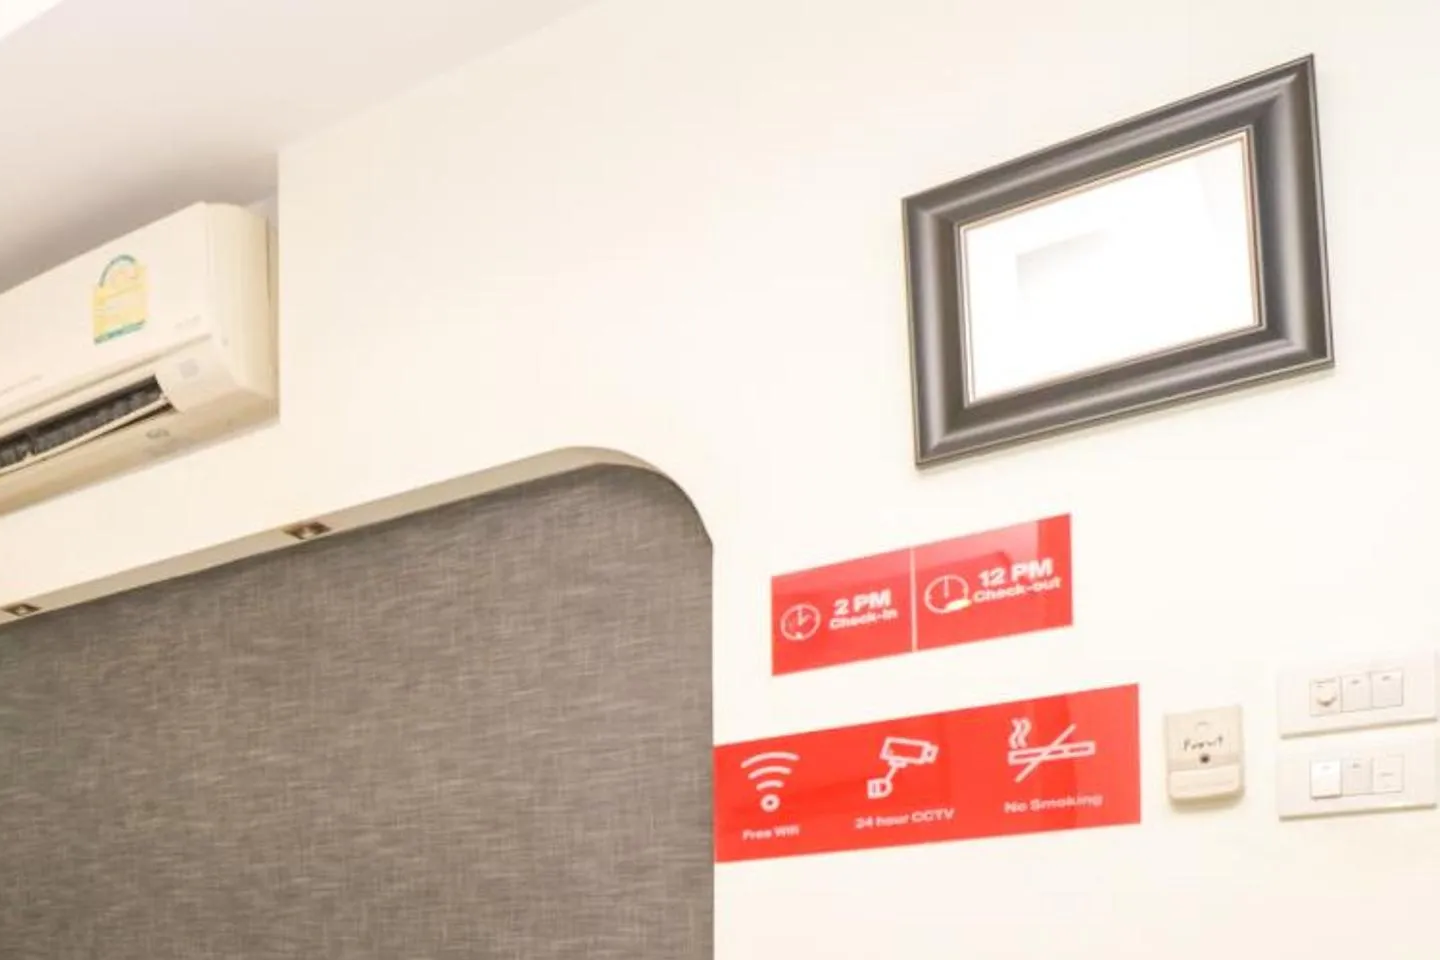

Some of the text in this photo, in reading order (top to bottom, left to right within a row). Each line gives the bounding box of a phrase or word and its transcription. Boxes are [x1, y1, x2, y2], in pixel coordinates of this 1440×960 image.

[978, 557, 1054, 588] 12 PM
[973, 576, 1062, 604] Check-out
[834, 589, 892, 617] 2 PM
[828, 607, 898, 631] Check-in
[910, 807, 956, 824] CCTV
[1003, 794, 1103, 814] No Smoking
[742, 828, 772, 841] Free
